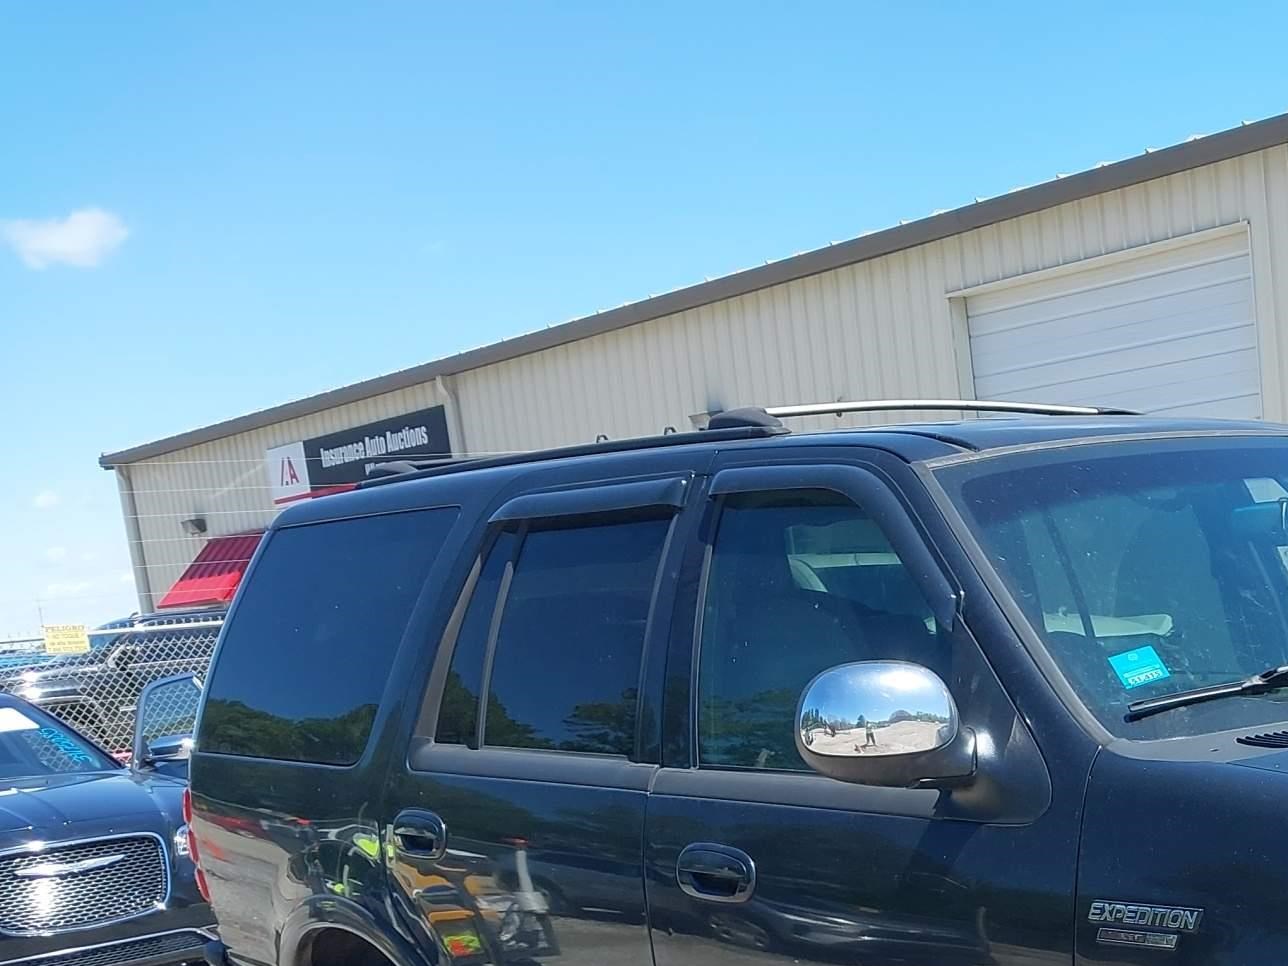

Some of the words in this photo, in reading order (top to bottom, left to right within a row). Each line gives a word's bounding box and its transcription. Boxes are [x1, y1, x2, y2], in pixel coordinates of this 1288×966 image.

[320, 441, 365, 468] Insurance
[364, 436, 386, 457] Auto
[386, 426, 428, 453] Auctions
[1088, 902, 1199, 930] EXPEDITION
